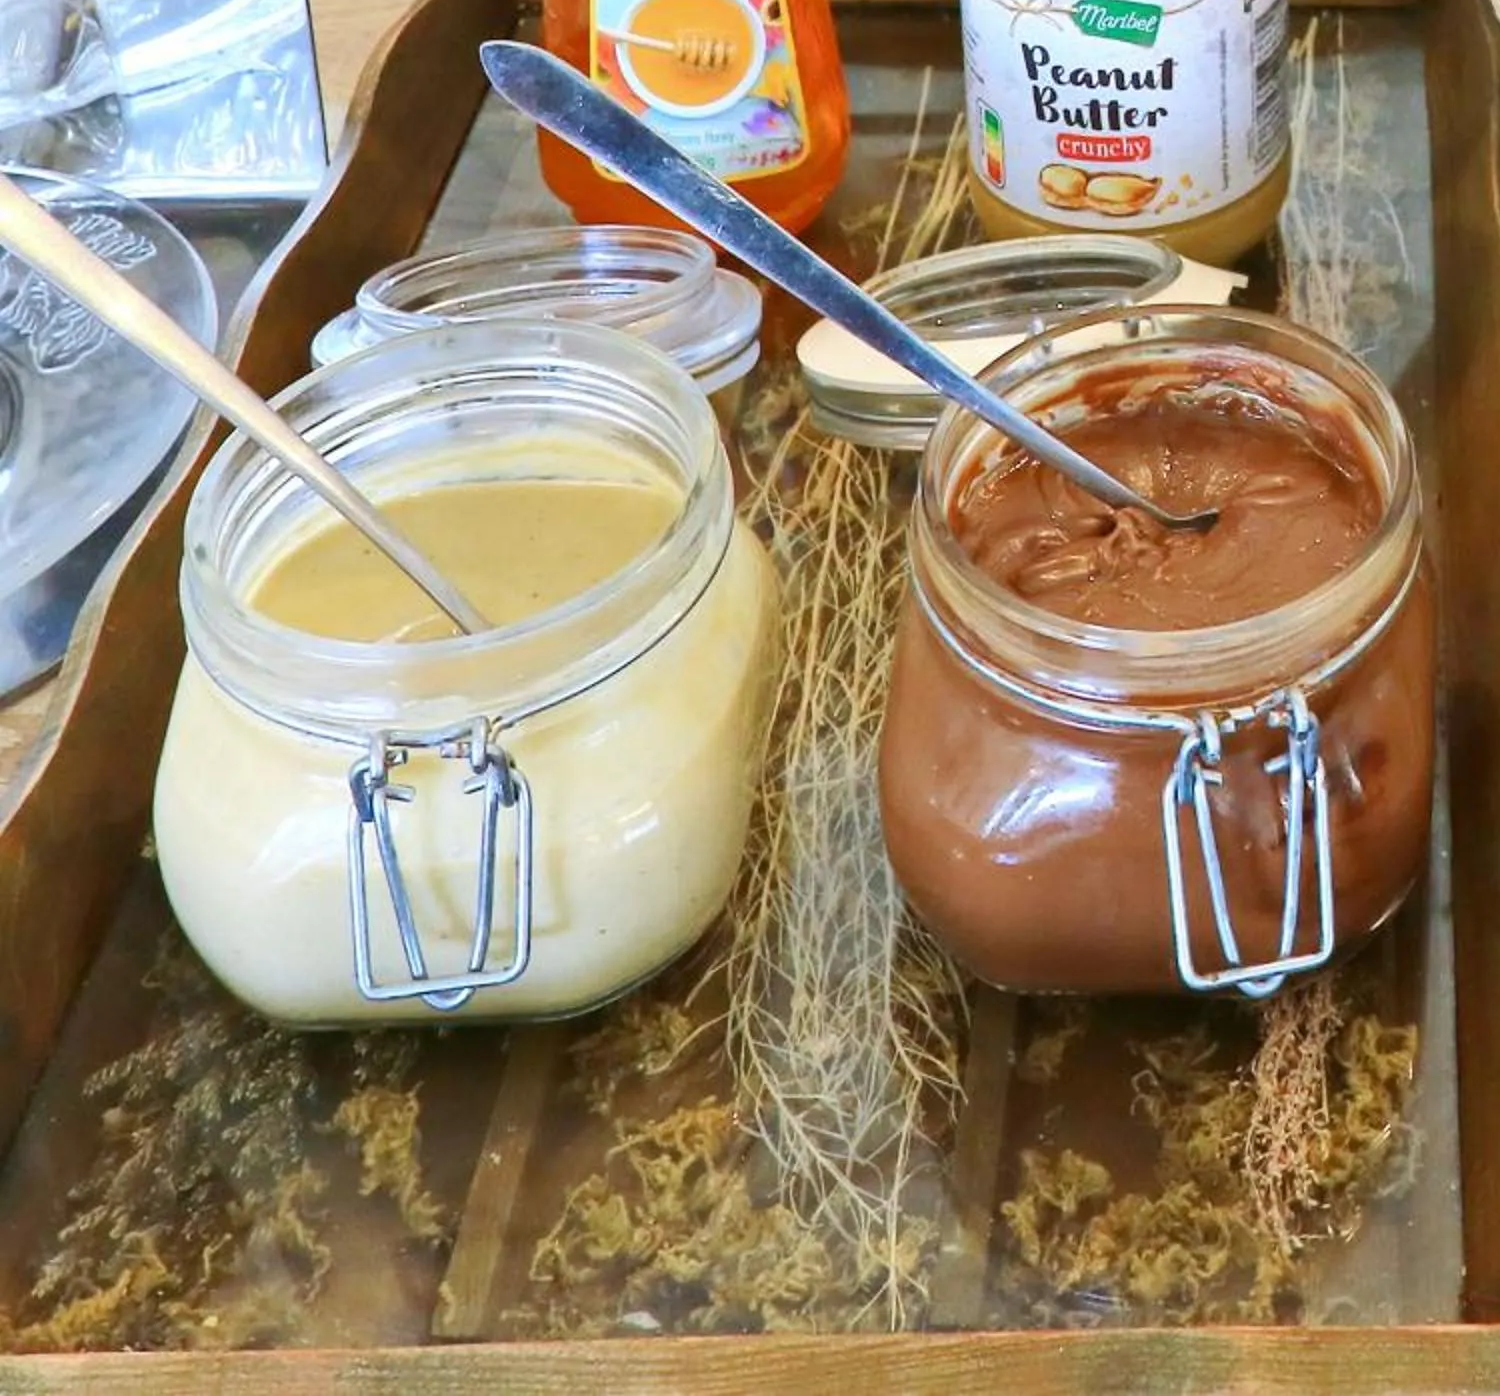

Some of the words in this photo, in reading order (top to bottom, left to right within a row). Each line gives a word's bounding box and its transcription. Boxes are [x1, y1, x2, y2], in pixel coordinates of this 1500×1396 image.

[1078, 5, 1158, 34] Maribel
[1021, 42, 1180, 91] Peanut
[1031, 85, 1169, 131] Butter
[1058, 138, 1149, 162] crunchy
